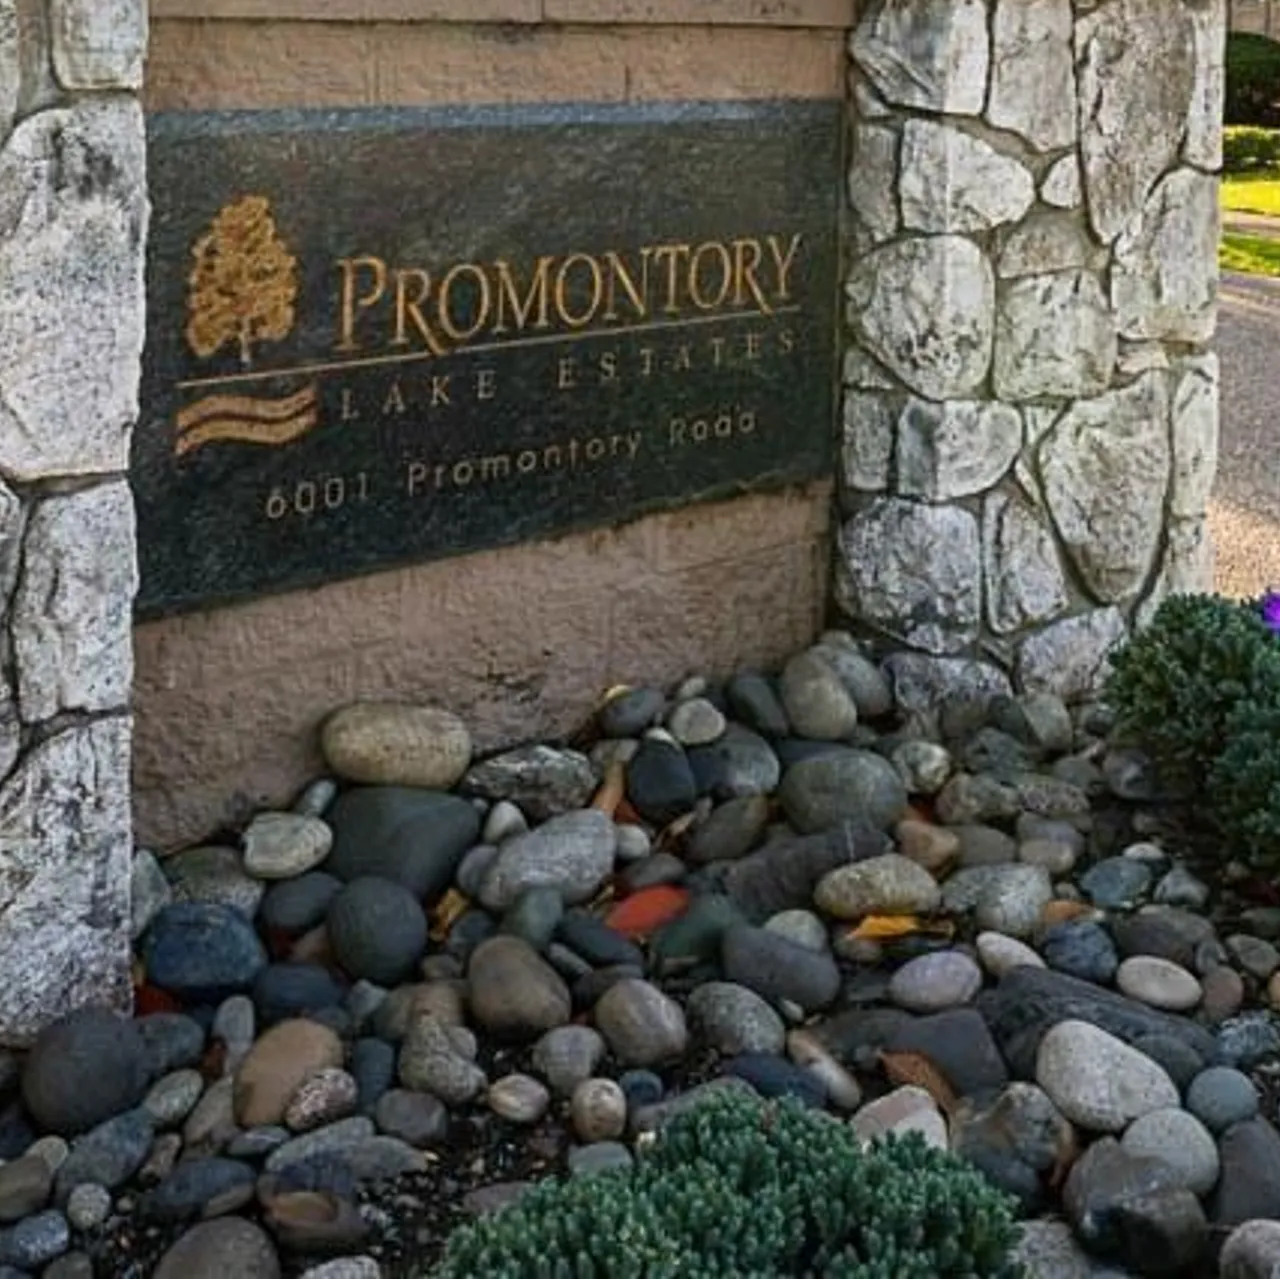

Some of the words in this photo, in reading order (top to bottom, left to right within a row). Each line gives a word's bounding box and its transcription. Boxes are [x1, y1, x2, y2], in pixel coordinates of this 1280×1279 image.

[334, 234, 801, 355] PROMONTORY
[341, 372, 496, 420] LAKE
[558, 329, 794, 389] ESTATES
[266, 472, 368, 518] 6001
[407, 431, 641, 497] Promontory
[670, 403, 756, 446] Road
